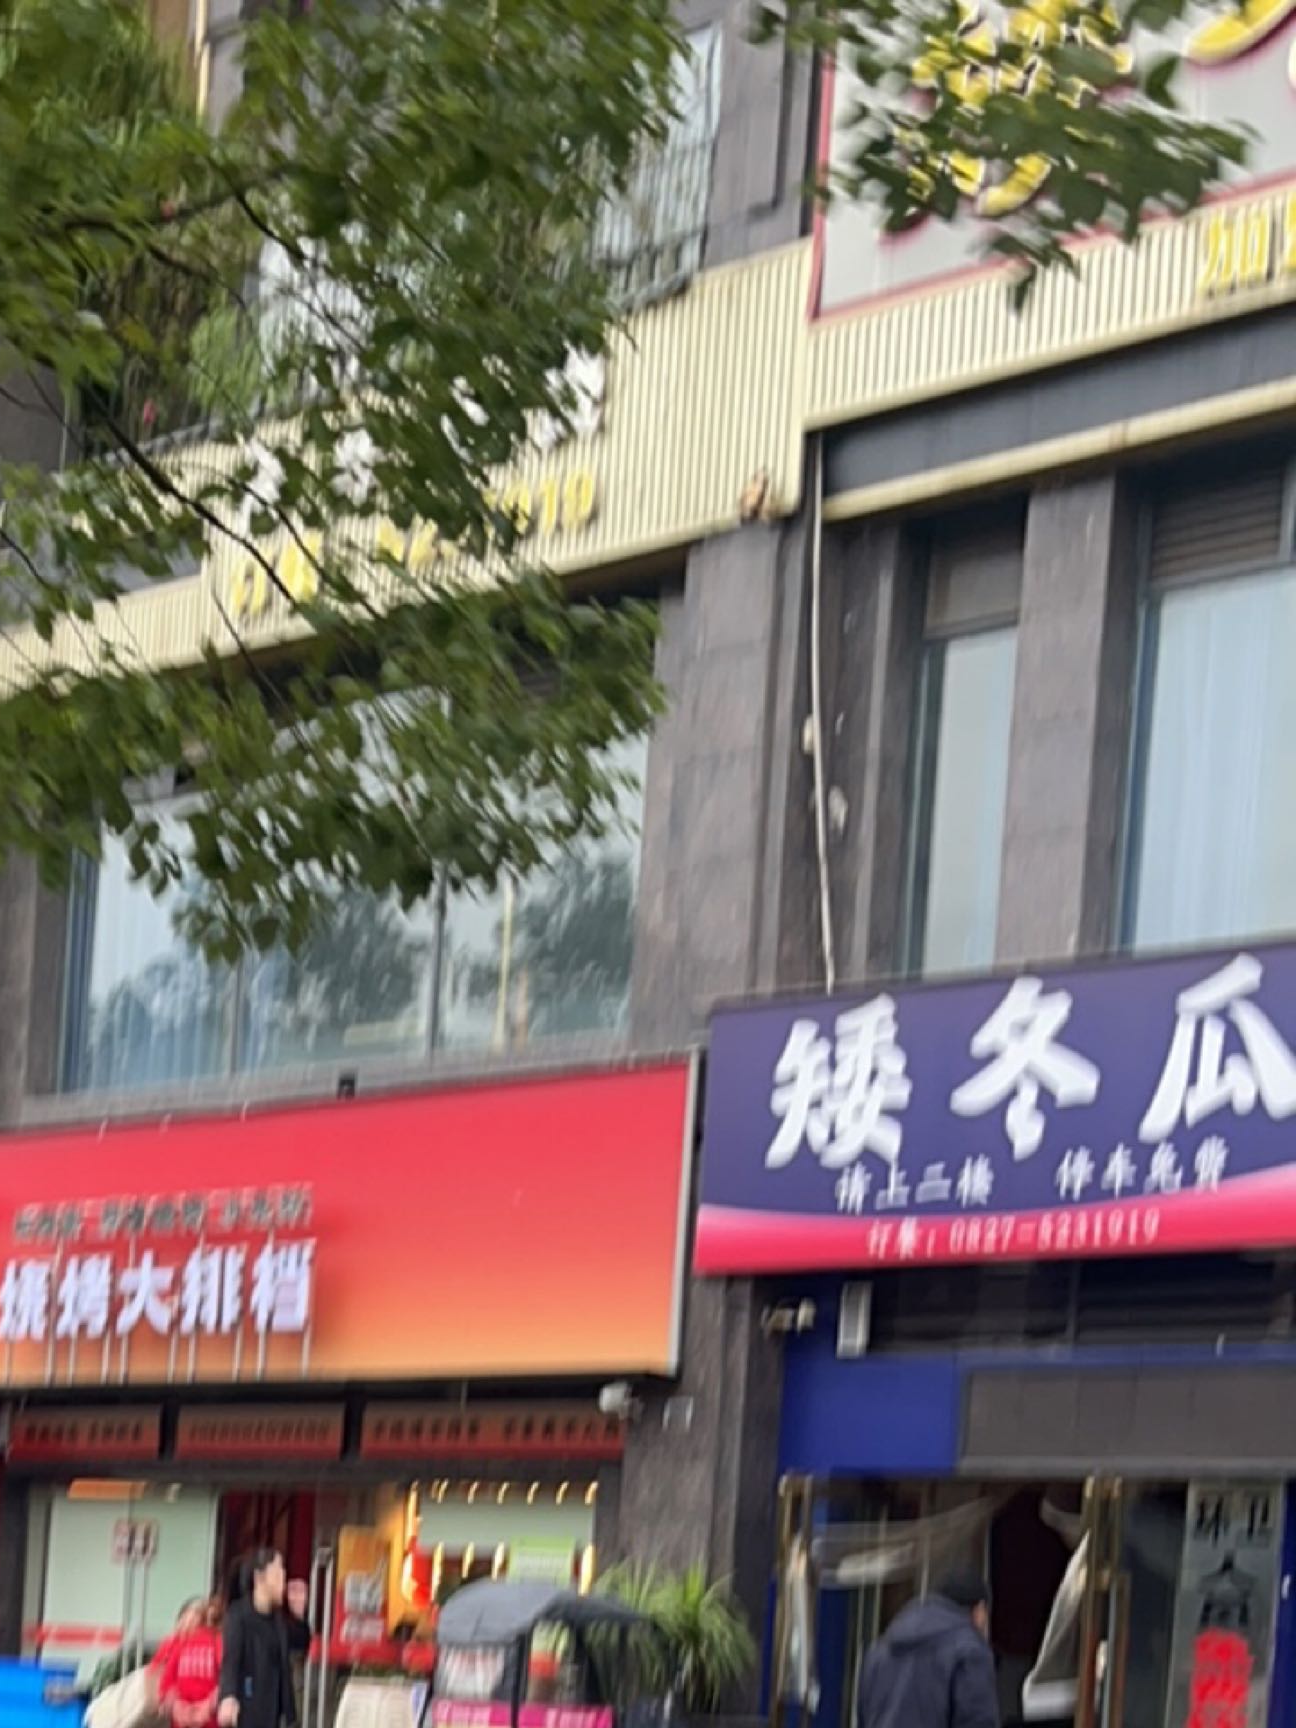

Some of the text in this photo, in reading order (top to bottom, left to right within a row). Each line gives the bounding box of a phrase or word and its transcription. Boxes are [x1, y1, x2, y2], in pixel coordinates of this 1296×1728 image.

[764, 952, 1296, 1169] 矮冬瓜
[835, 1134, 1229, 1215] 请上二楼 停车免费
